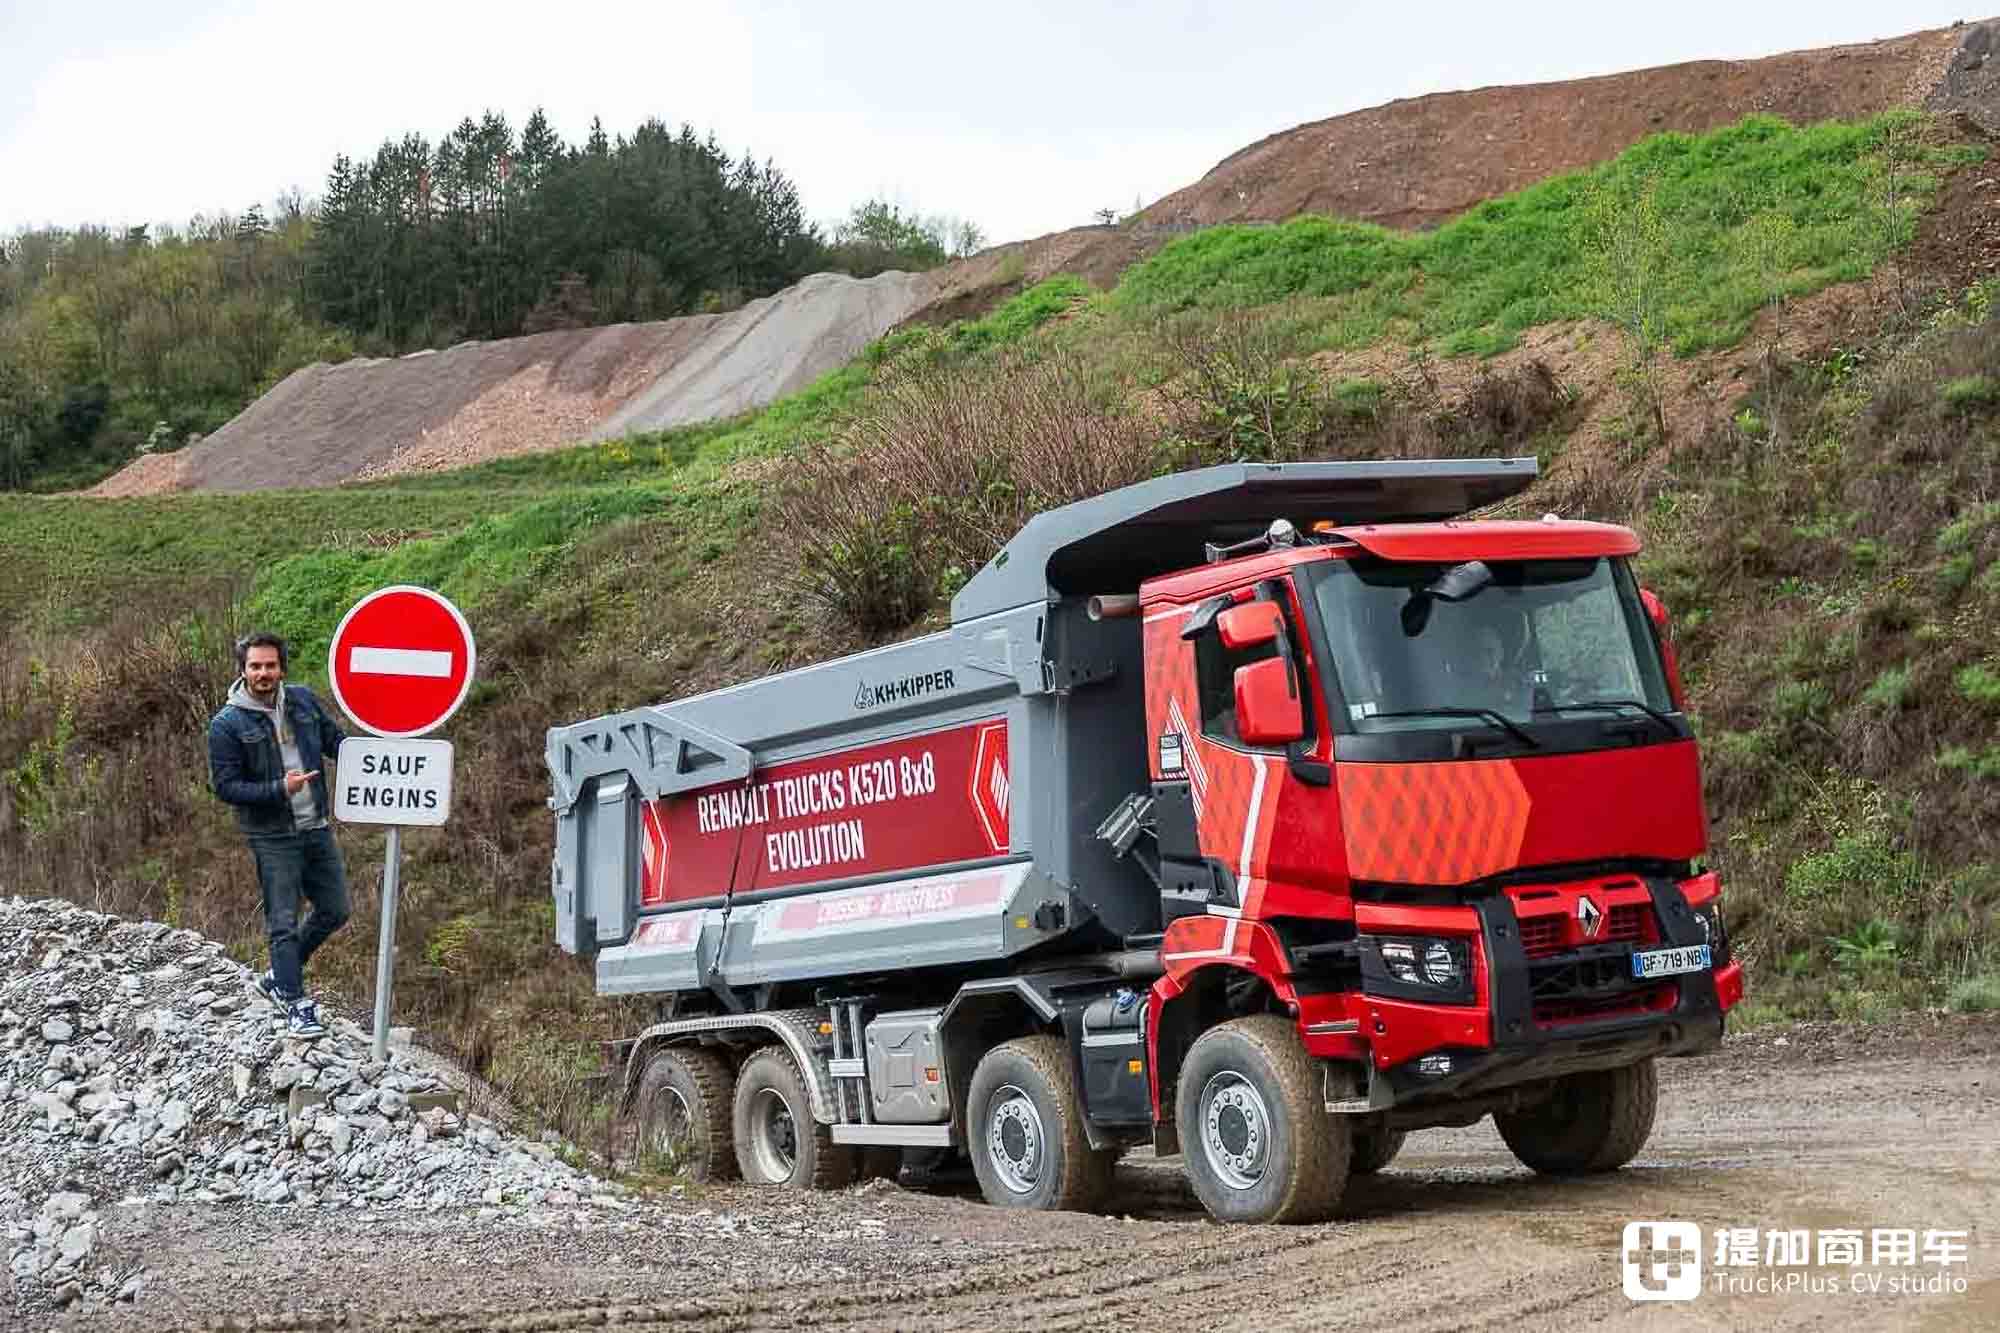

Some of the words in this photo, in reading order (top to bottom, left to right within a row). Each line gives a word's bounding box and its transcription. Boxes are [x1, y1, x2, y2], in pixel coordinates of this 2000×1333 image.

[362, 755, 427, 776] SAUF
[346, 786, 437, 809] ENGINS
[697, 783, 771, 833] RENAULT
[772, 769, 846, 820] TRUCKS
[848, 759, 897, 806] K520
[899, 751, 937, 797] 8x8
[765, 819, 866, 873] EVOLUTION
